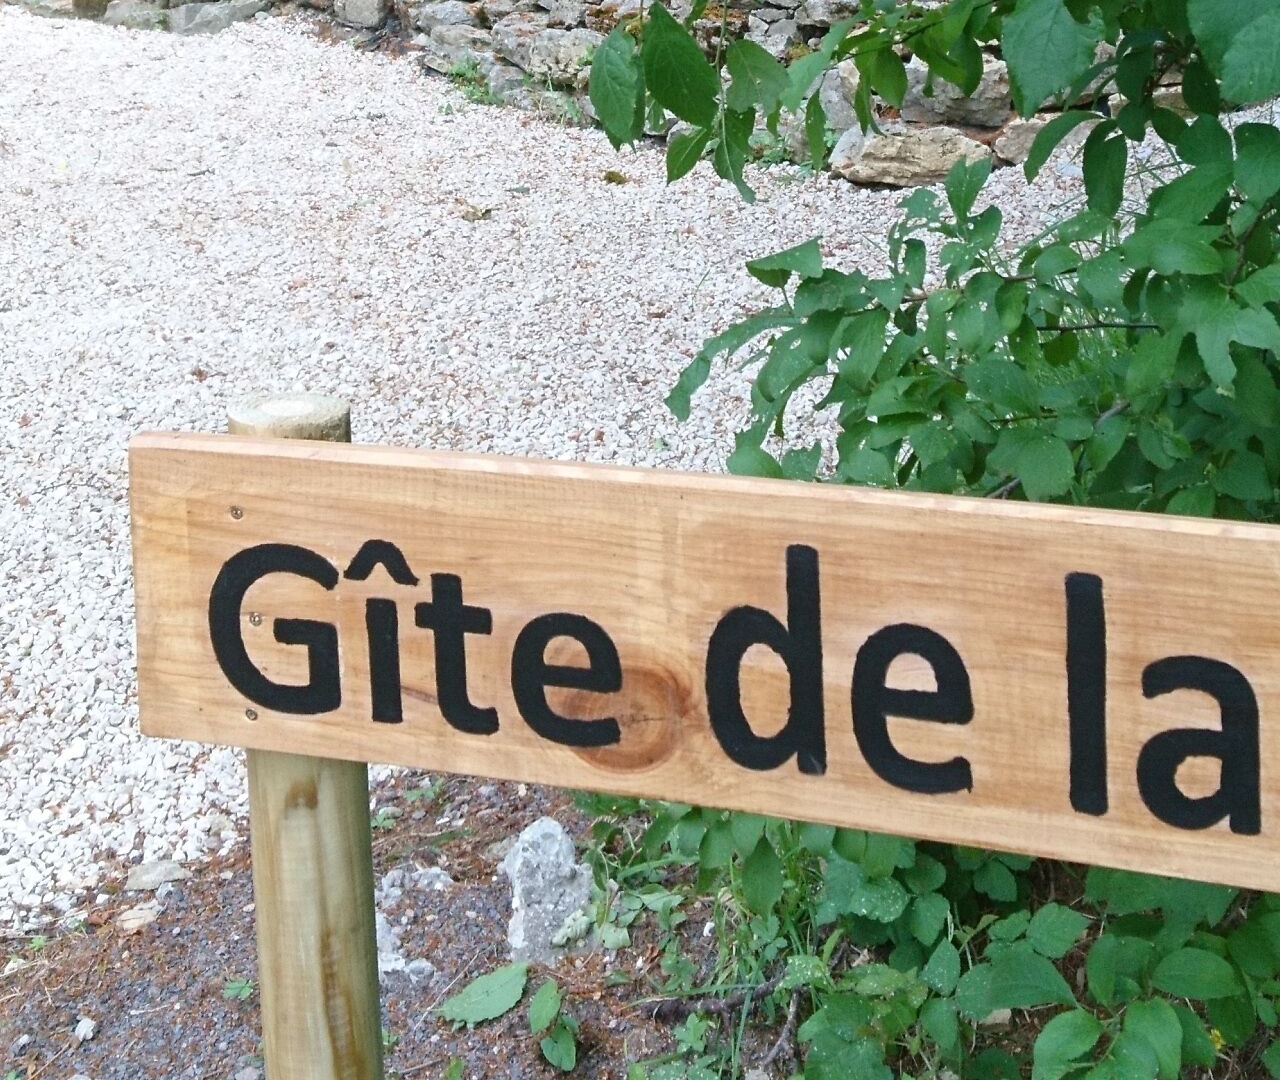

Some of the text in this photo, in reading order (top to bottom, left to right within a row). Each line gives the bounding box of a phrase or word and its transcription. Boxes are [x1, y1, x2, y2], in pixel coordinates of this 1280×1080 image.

[207, 538, 624, 750] Gîte
[704, 543, 975, 795] de
[1063, 571, 1262, 837] la
